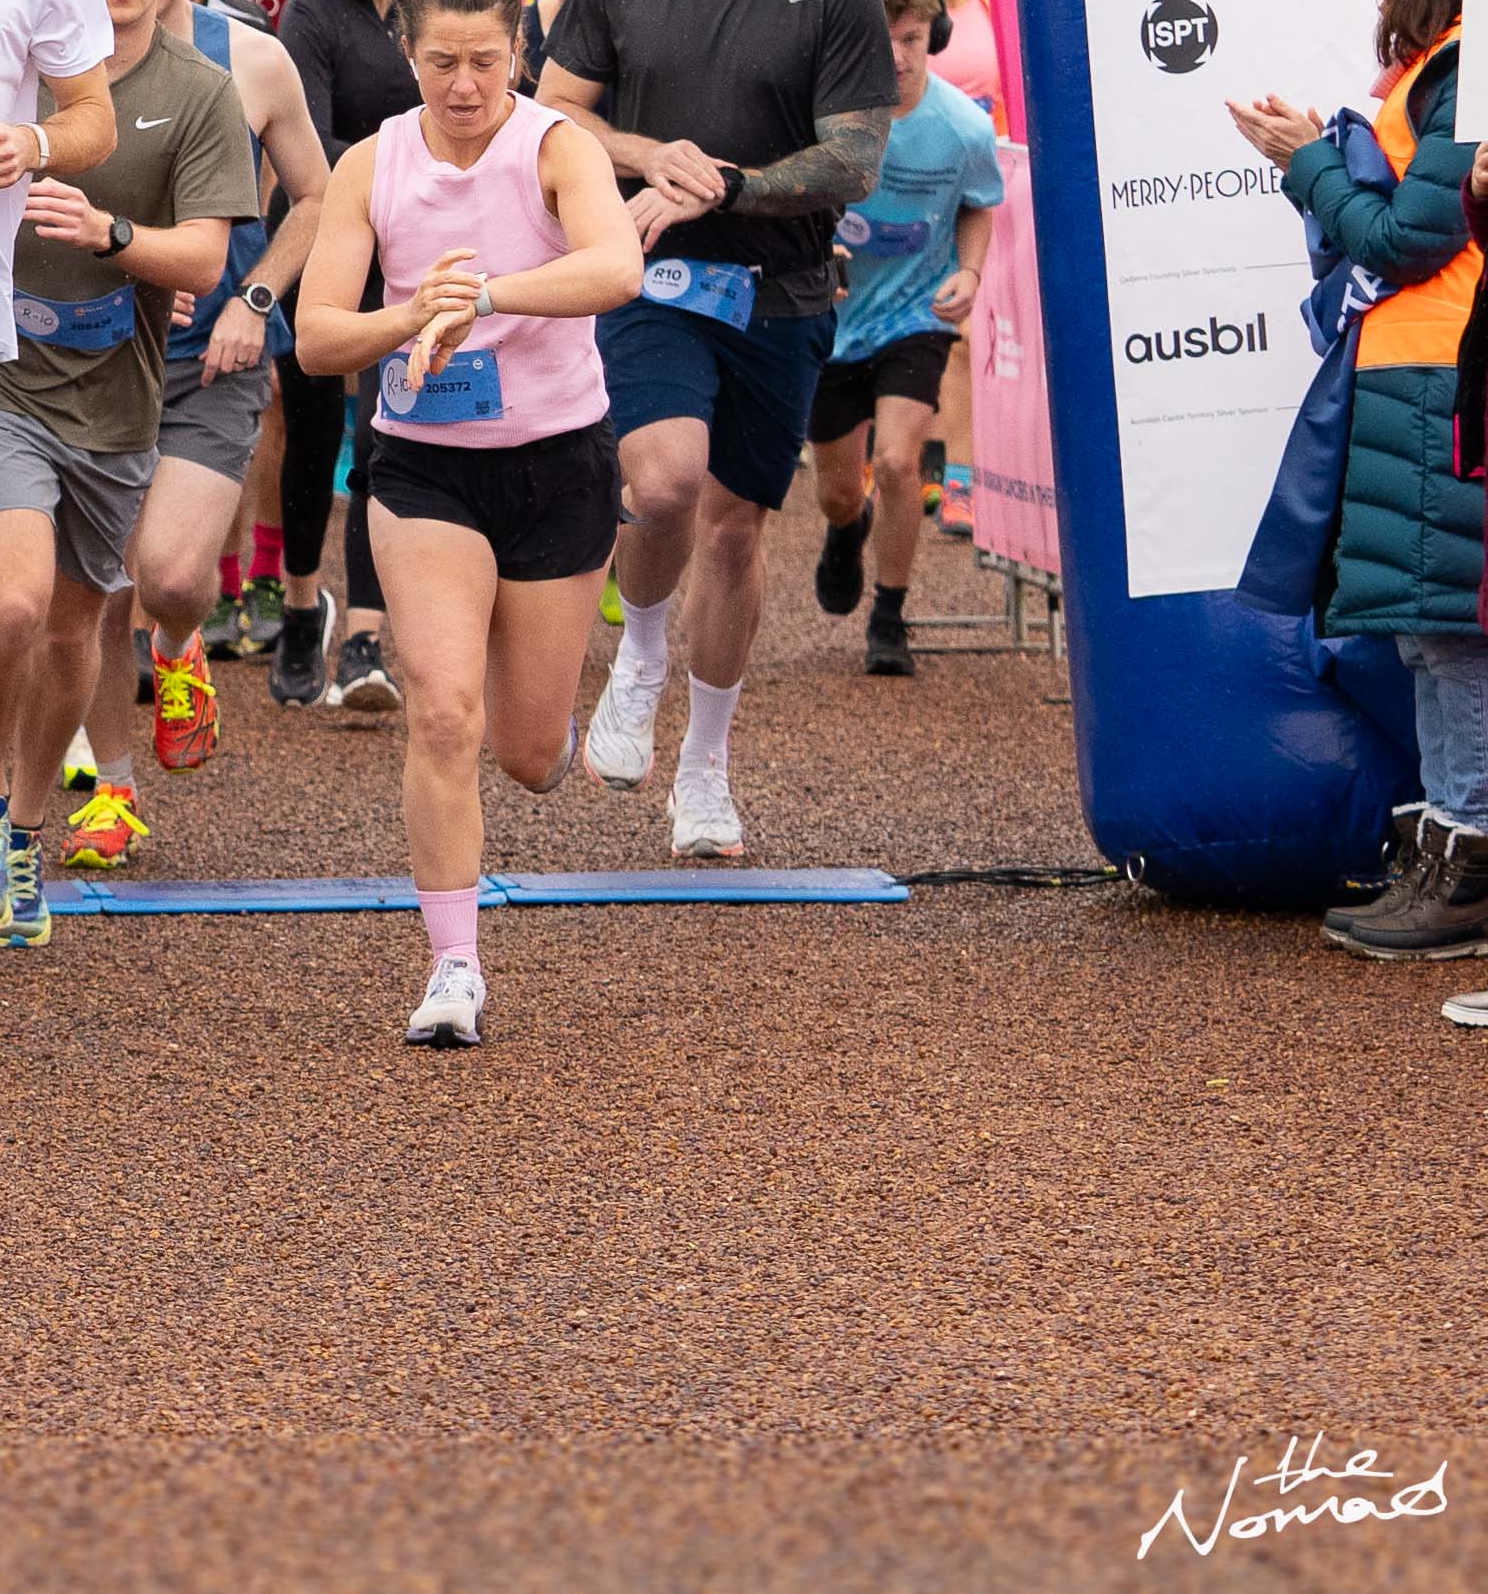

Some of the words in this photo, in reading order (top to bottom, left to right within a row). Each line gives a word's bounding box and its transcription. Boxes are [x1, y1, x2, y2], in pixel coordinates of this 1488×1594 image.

[1147, 17, 1209, 48] ISPT
[654, 268, 682, 281] R10
[425, 382, 472, 394] 205372
